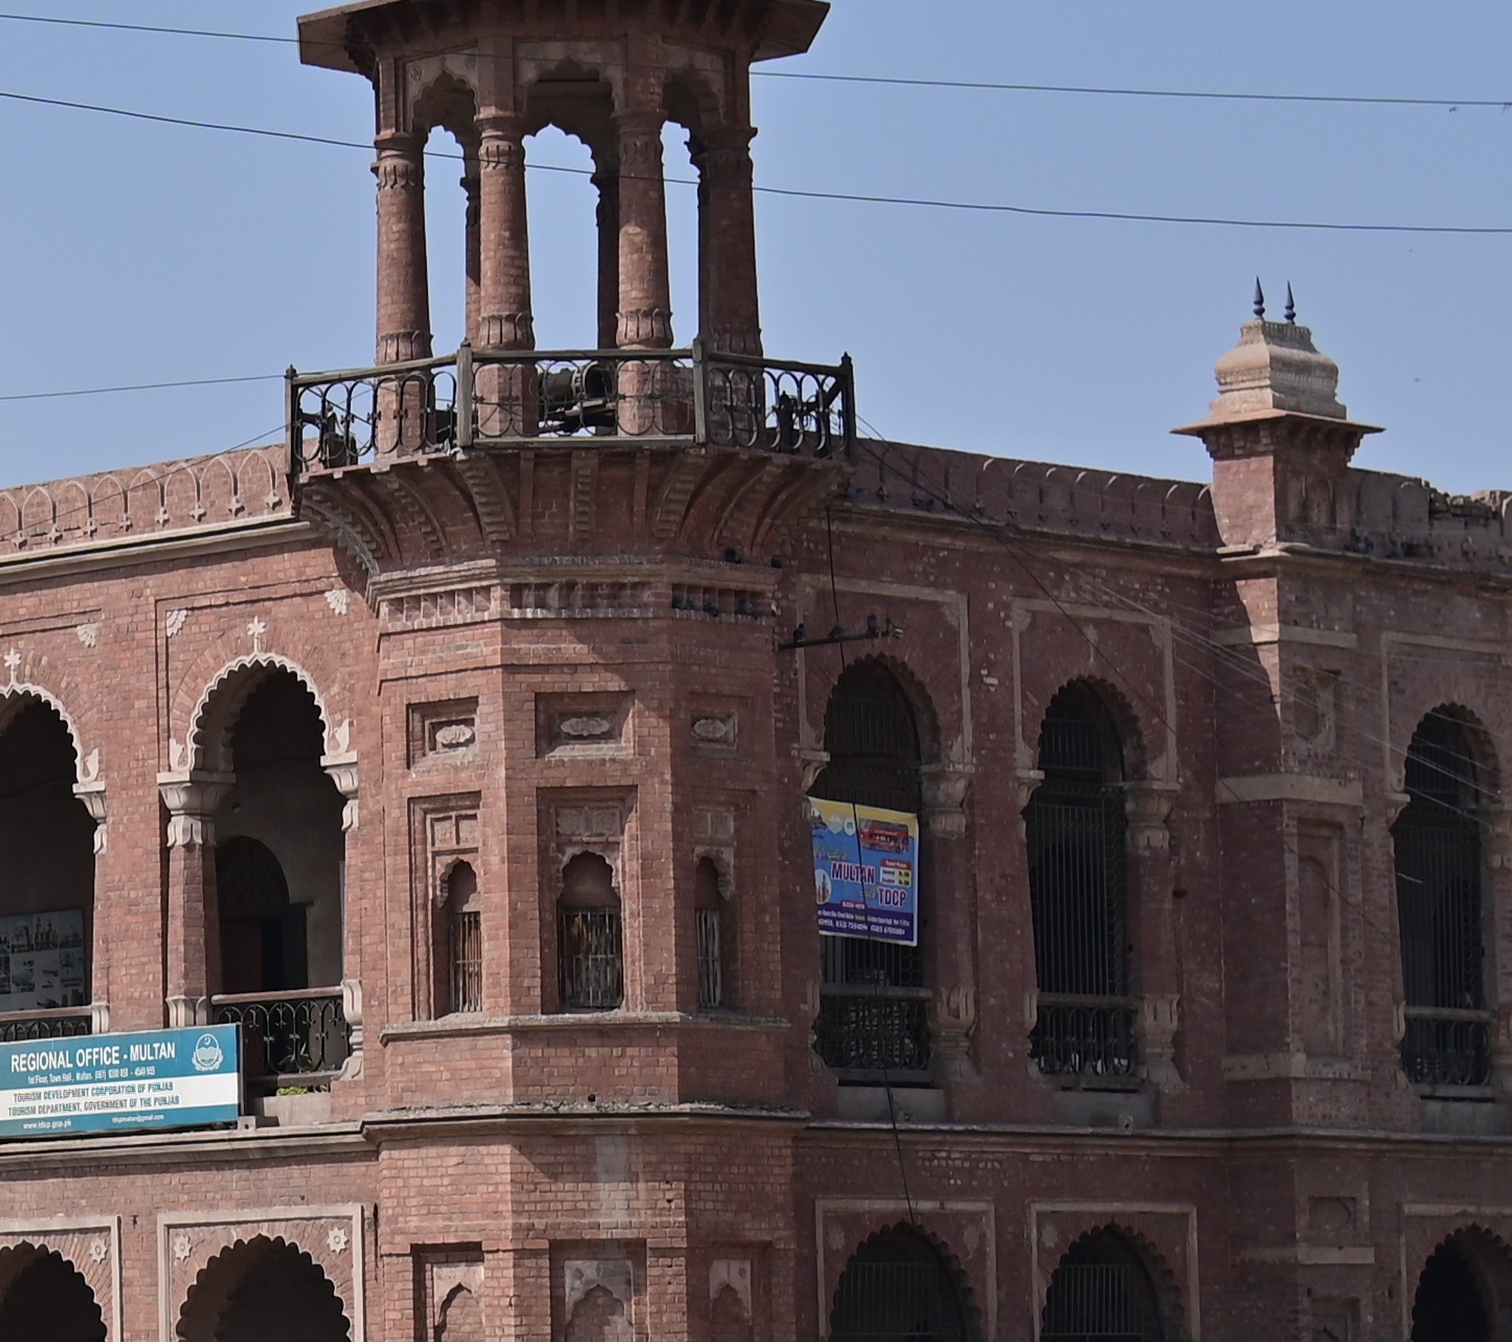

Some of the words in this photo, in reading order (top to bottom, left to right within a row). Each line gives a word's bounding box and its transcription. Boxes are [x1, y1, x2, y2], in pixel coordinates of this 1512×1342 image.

[831, 860, 875, 884] MULTAN
[11, 1050, 73, 1073] REGIONAL
[76, 1046, 120, 1067] OFFICE
[130, 1042, 175, 1061] MULTAN
[14, 1091, 42, 1102] TOURISM
[44, 1088, 89, 1100] DEVELOPMENT
[91, 1084, 135, 1097] CORPORATION
[138, 1084, 145, 1093] OF
[148, 1081, 173, 1092] PUNJAB
[8, 1106, 36, 1116] TOURISM
[38, 1102, 82, 1114] DEPARTMENT,
[84, 1099, 127, 1111] GOVERNMENT
[130, 1098, 137, 1108] OF
[139, 1097, 152, 1107] THE
[154, 1095, 179, 1106] PUNJAB
